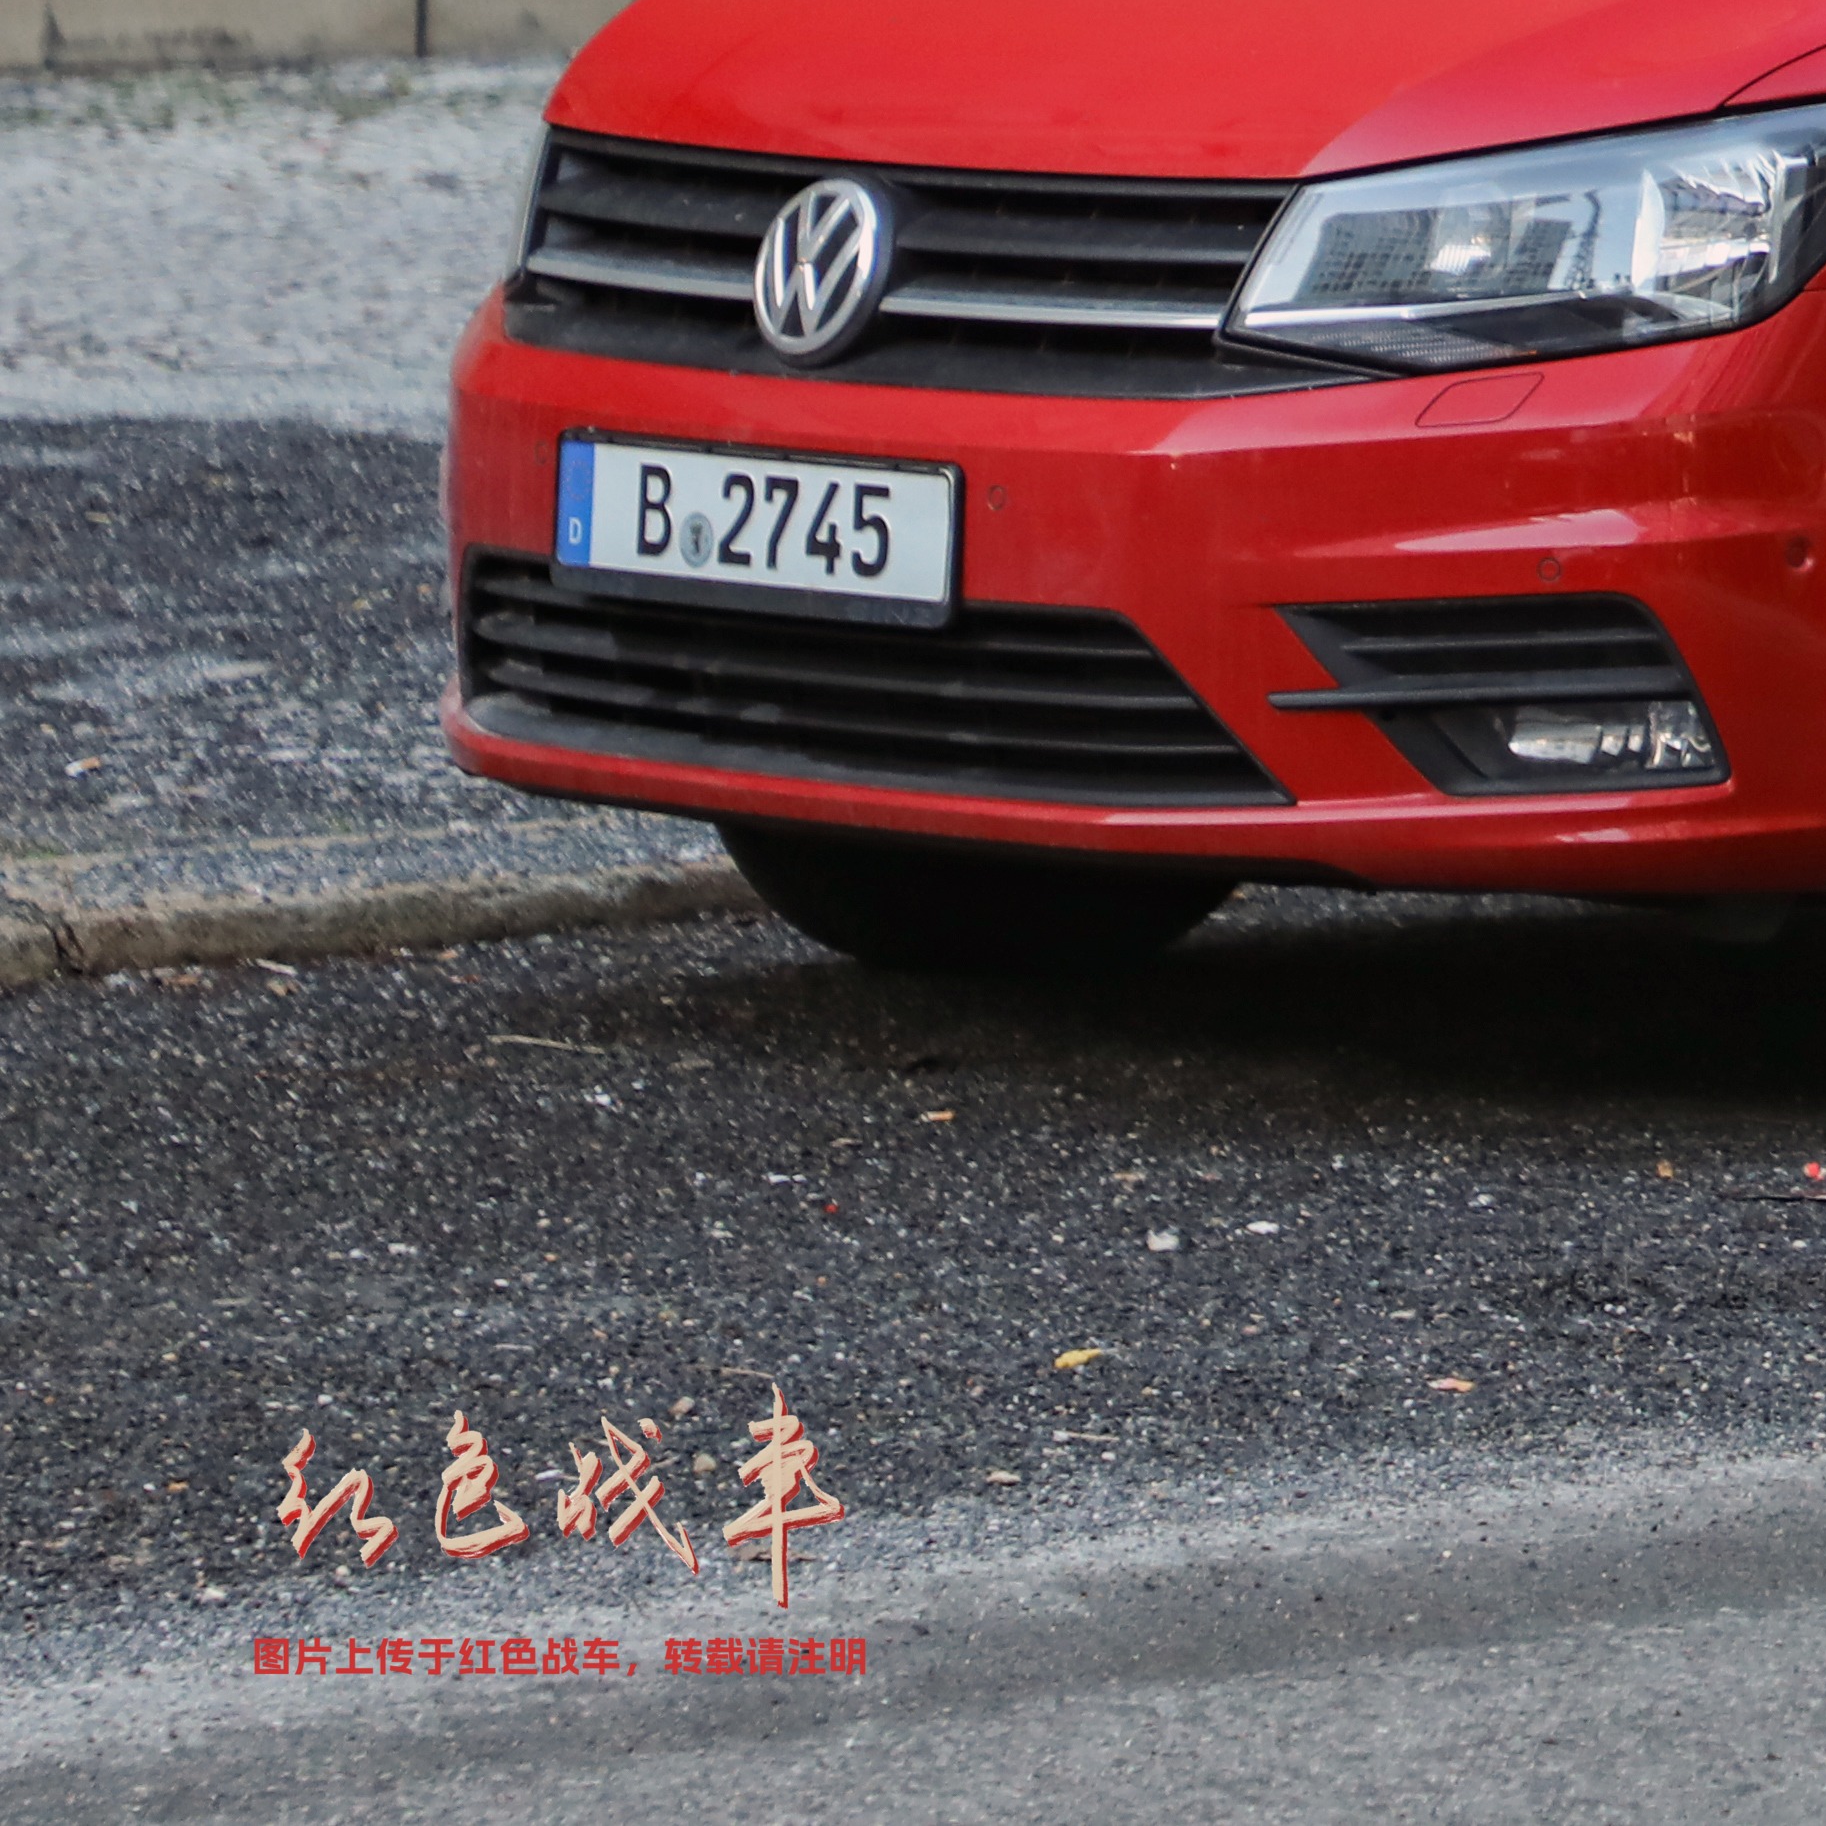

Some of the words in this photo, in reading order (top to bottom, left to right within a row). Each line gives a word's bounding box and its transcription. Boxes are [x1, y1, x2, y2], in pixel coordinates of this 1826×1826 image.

[569, 517, 582, 545] D
[637, 464, 672, 556] B
[717, 473, 890, 577] 2745
